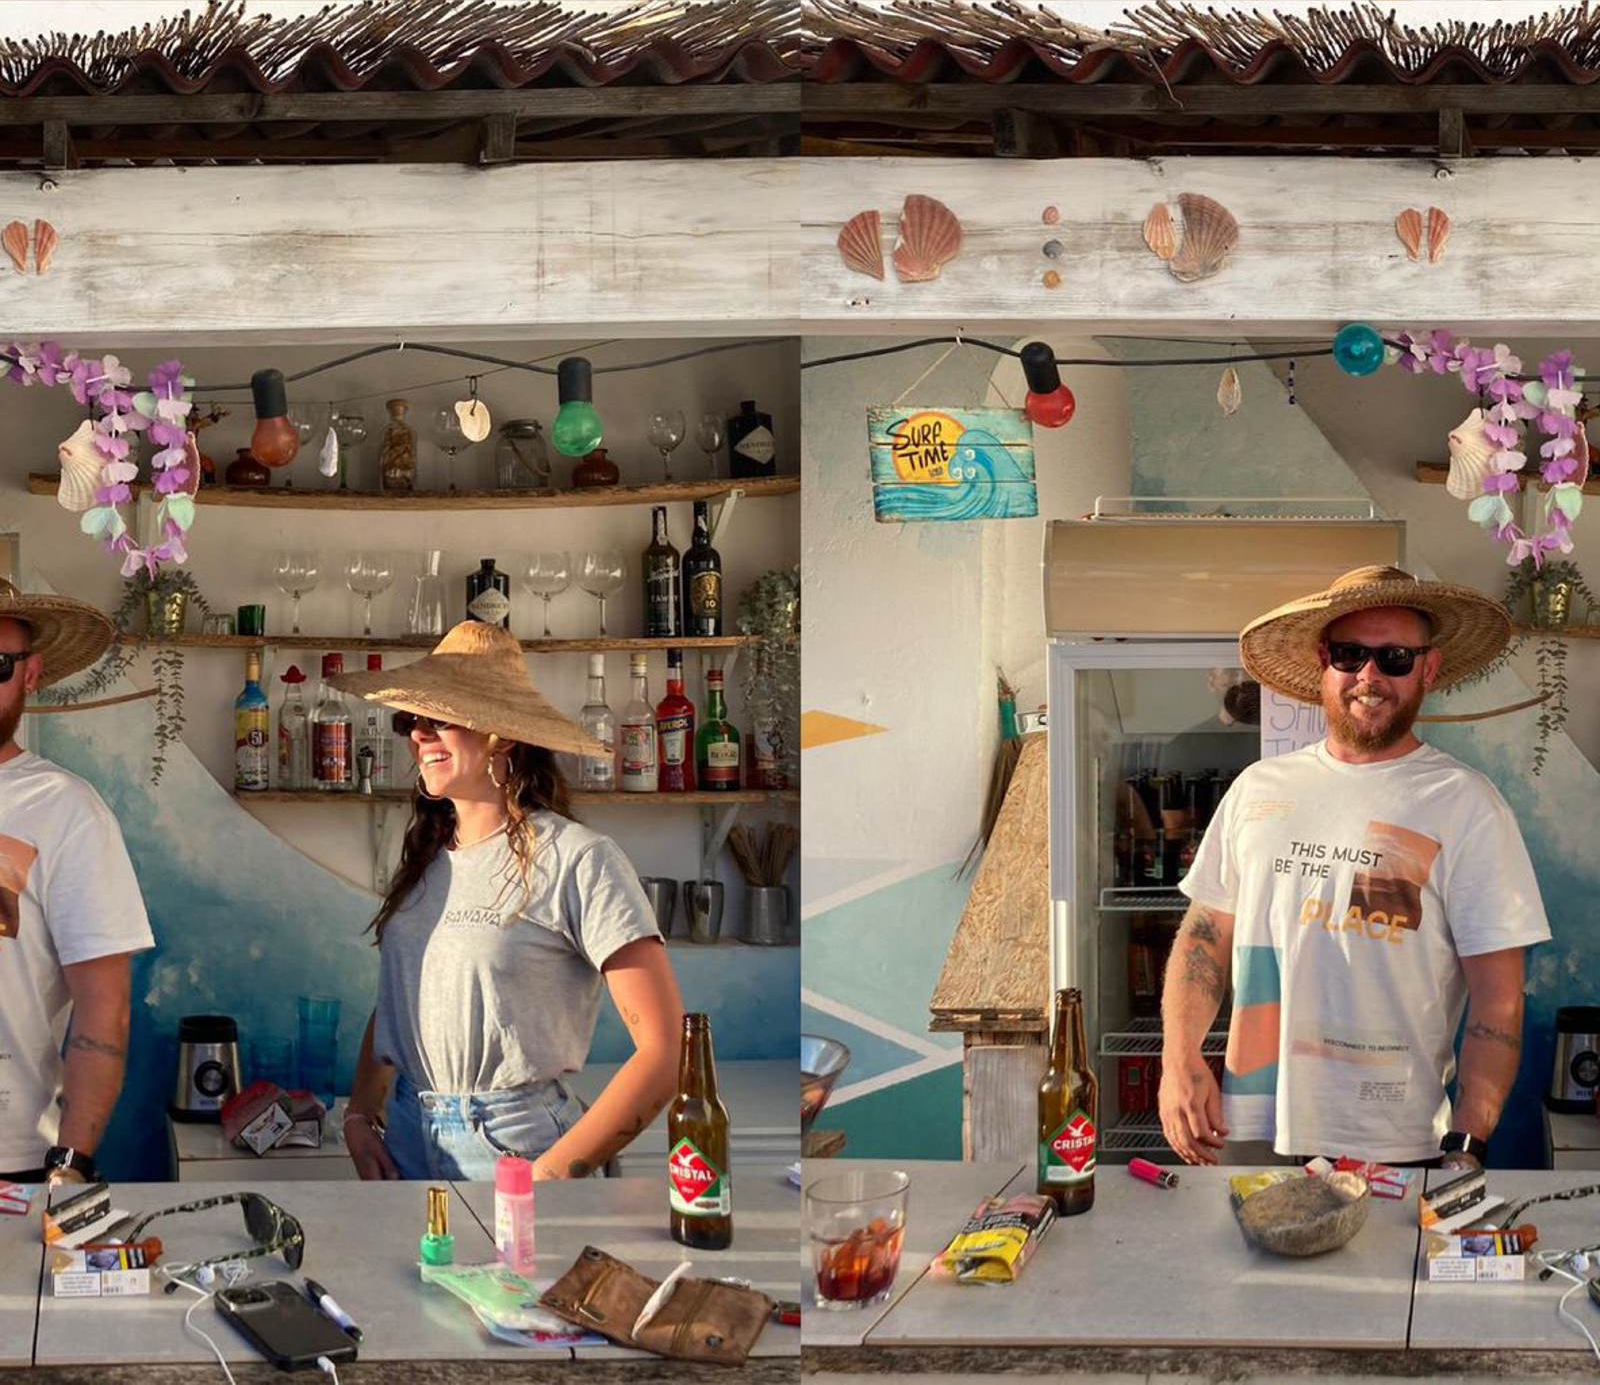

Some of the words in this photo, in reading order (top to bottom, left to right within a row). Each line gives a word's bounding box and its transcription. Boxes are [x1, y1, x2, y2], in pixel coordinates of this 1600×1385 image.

[886, 418, 943, 451] SURF
[898, 440, 950, 472] TIME
[250, 729, 264, 746] 51
[1290, 841, 1326, 860] THIS
[1332, 846, 1383, 868] MUST
[1275, 858, 1293, 874] BE
[1301, 861, 1331, 879] THE
[1300, 897, 1408, 944] PLACE
[669, 1162, 713, 1182] RISTAL
